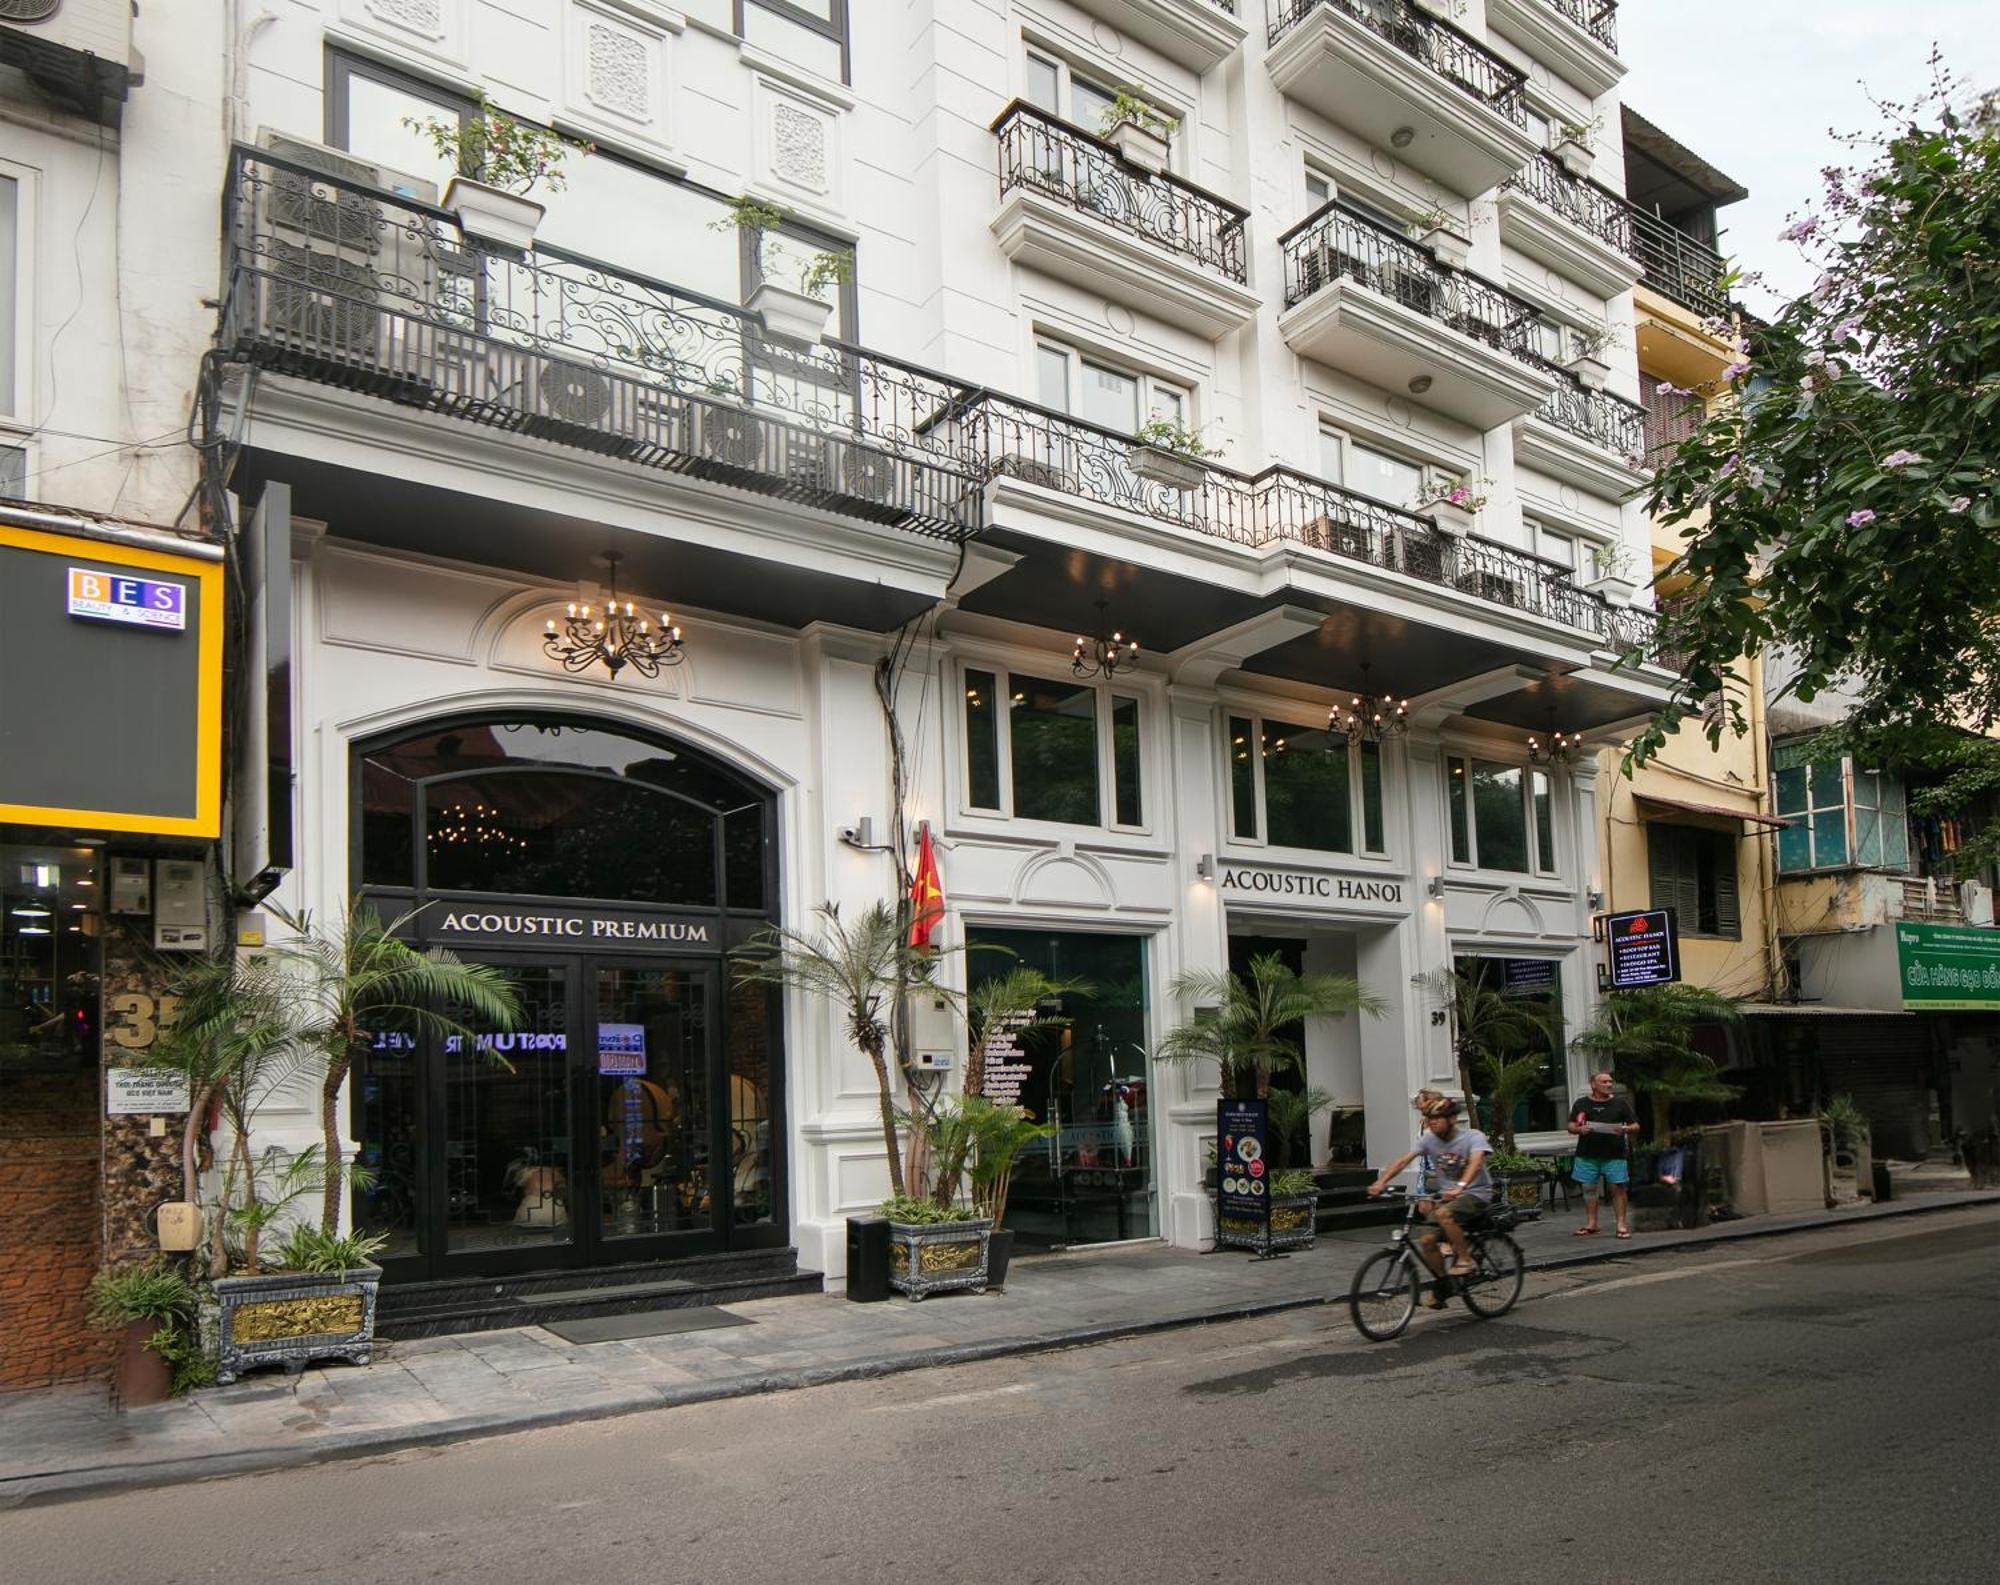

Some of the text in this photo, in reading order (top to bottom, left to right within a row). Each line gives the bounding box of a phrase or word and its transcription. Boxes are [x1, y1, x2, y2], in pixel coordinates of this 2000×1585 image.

[82, 575, 174, 610] BES
[1221, 869, 1403, 903] ACOUSTIC HANOI
[440, 913, 709, 942] ACOUSTIC PREMIUM
[1431, 1011, 1446, 1026] 39
